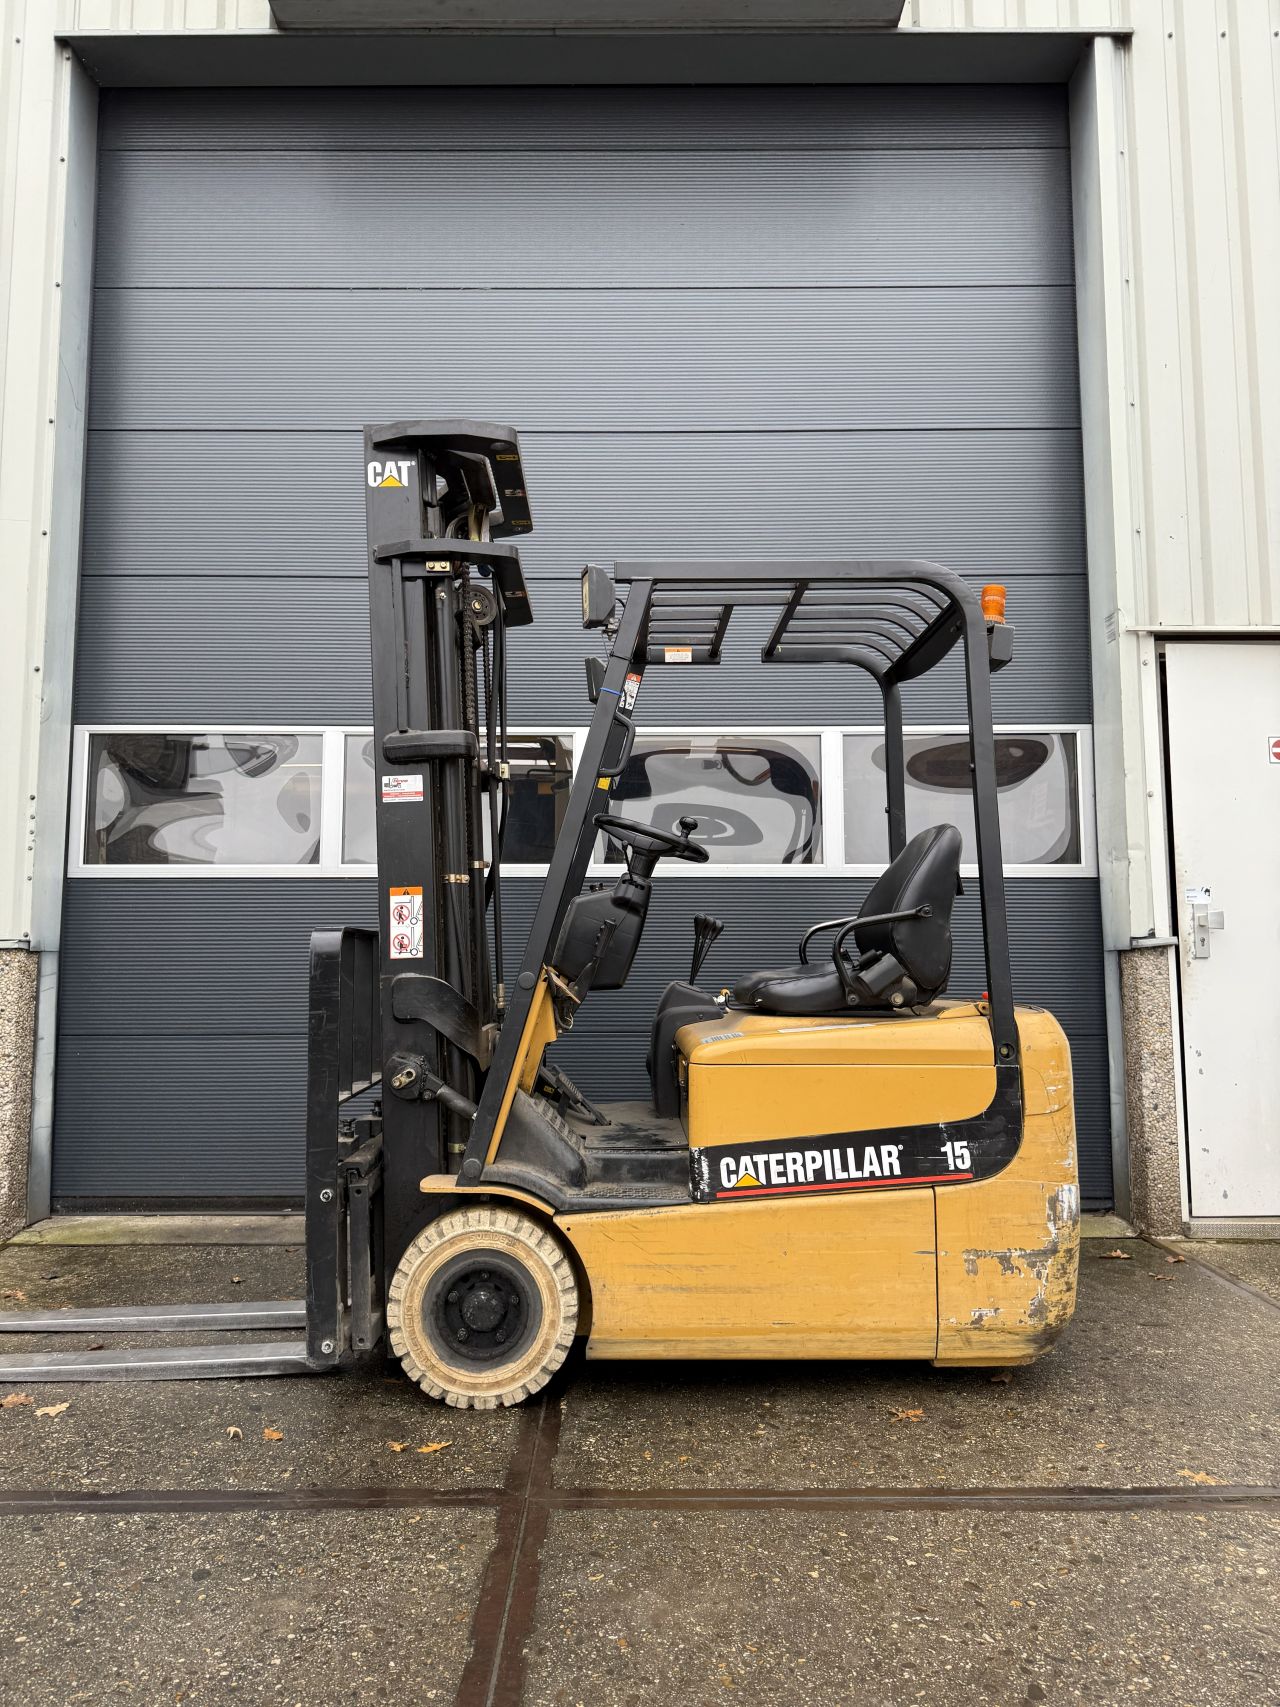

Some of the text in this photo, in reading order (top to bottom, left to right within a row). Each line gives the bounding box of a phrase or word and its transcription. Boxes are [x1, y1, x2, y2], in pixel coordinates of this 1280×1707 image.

[367, 461, 411, 487] CAT
[719, 1140, 972, 1189] CATERPILLAR 15
